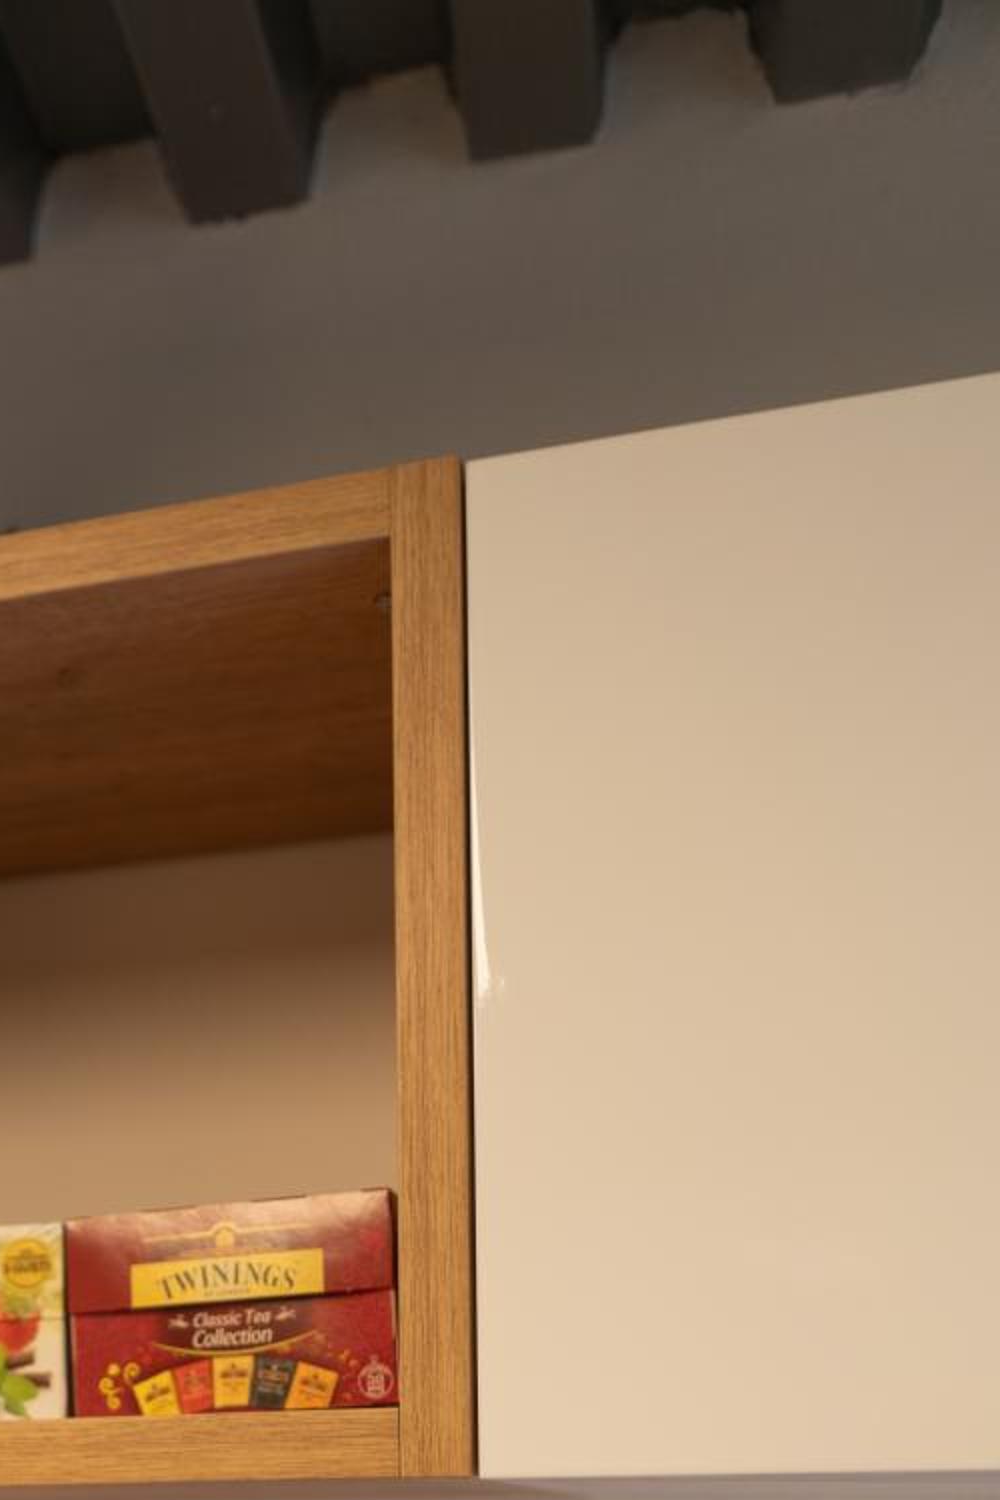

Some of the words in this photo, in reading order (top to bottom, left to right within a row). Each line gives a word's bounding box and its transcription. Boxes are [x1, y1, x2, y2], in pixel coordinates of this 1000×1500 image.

[158, 1262, 297, 1300] TWININGS
[192, 1311, 242, 1328] Classic
[245, 1307, 272, 1323] Tea
[192, 1328, 273, 1348] Collection
